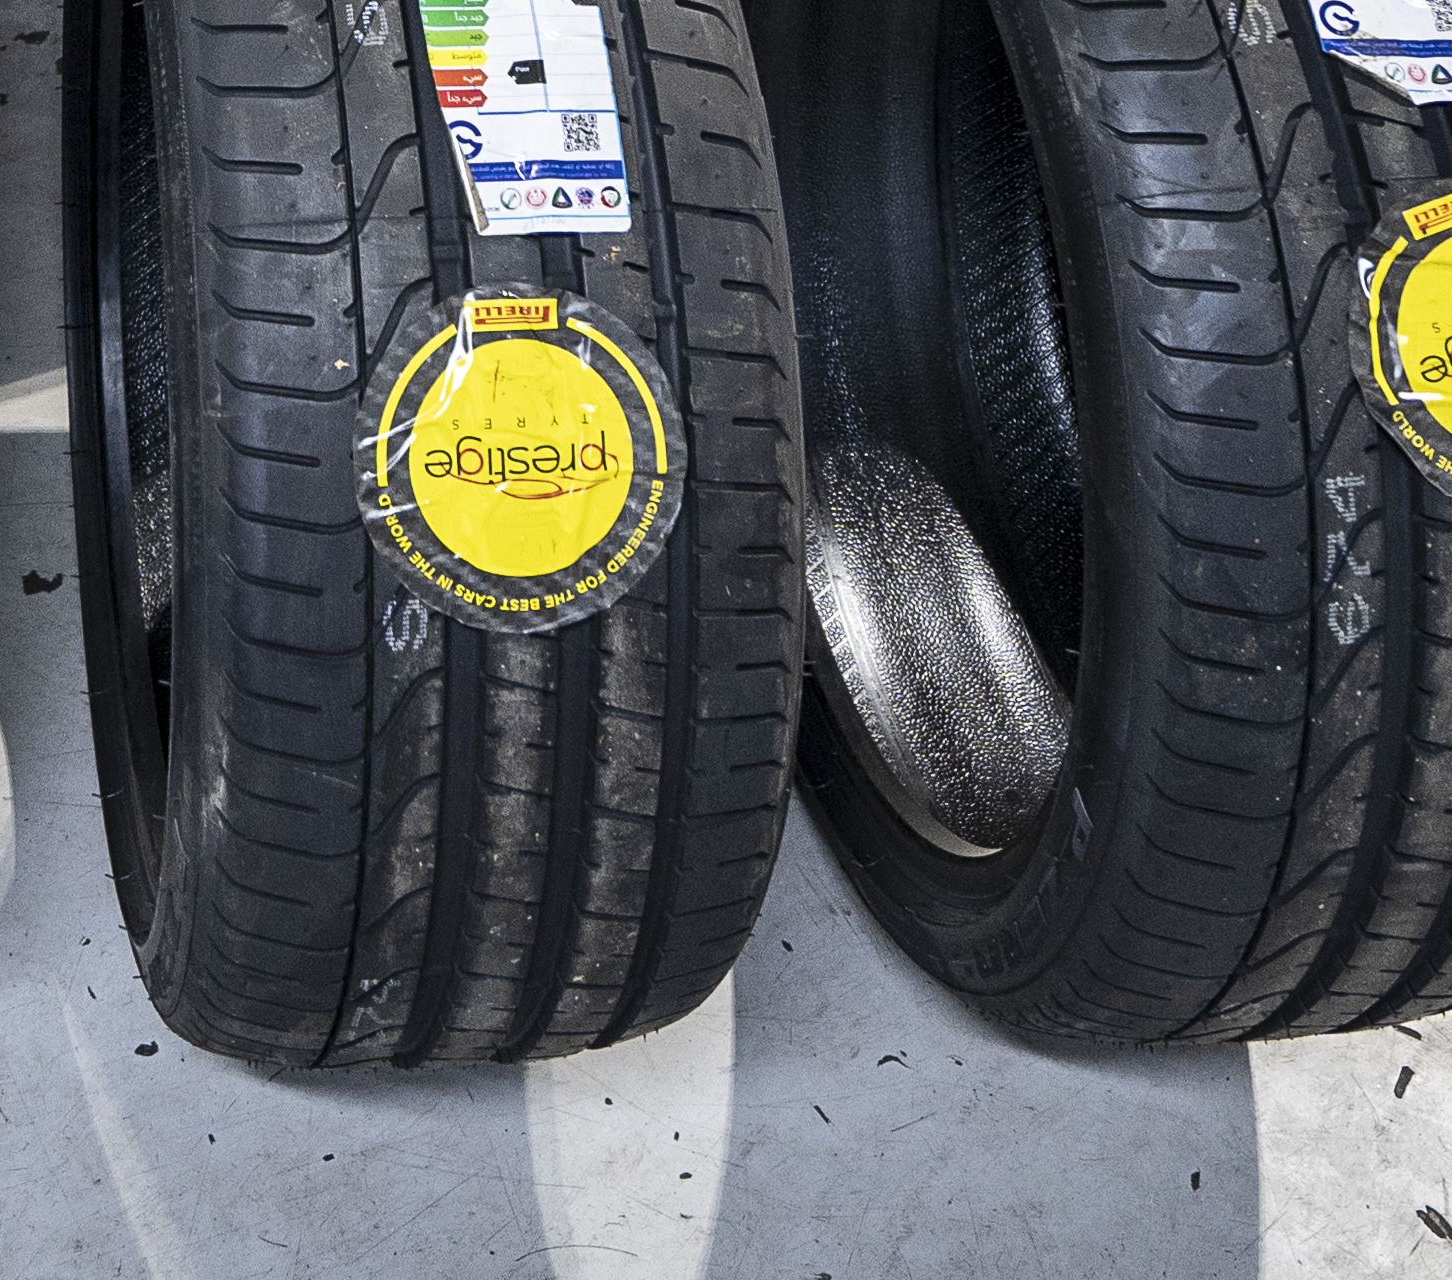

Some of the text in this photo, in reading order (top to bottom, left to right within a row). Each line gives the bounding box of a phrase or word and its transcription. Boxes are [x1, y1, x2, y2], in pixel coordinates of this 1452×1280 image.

[471, 13, 484, 22] جيد
[452, 52, 482, 60] متوسط
[475, 305, 551, 324] PIRELLI
[453, 412, 590, 430] TYRES
[1391, 410, 1436, 461] WORLD
[425, 429, 612, 483] prestige
[378, 479, 664, 612] ENGINEERED FOR THE BEST CARS IN THE WORD
